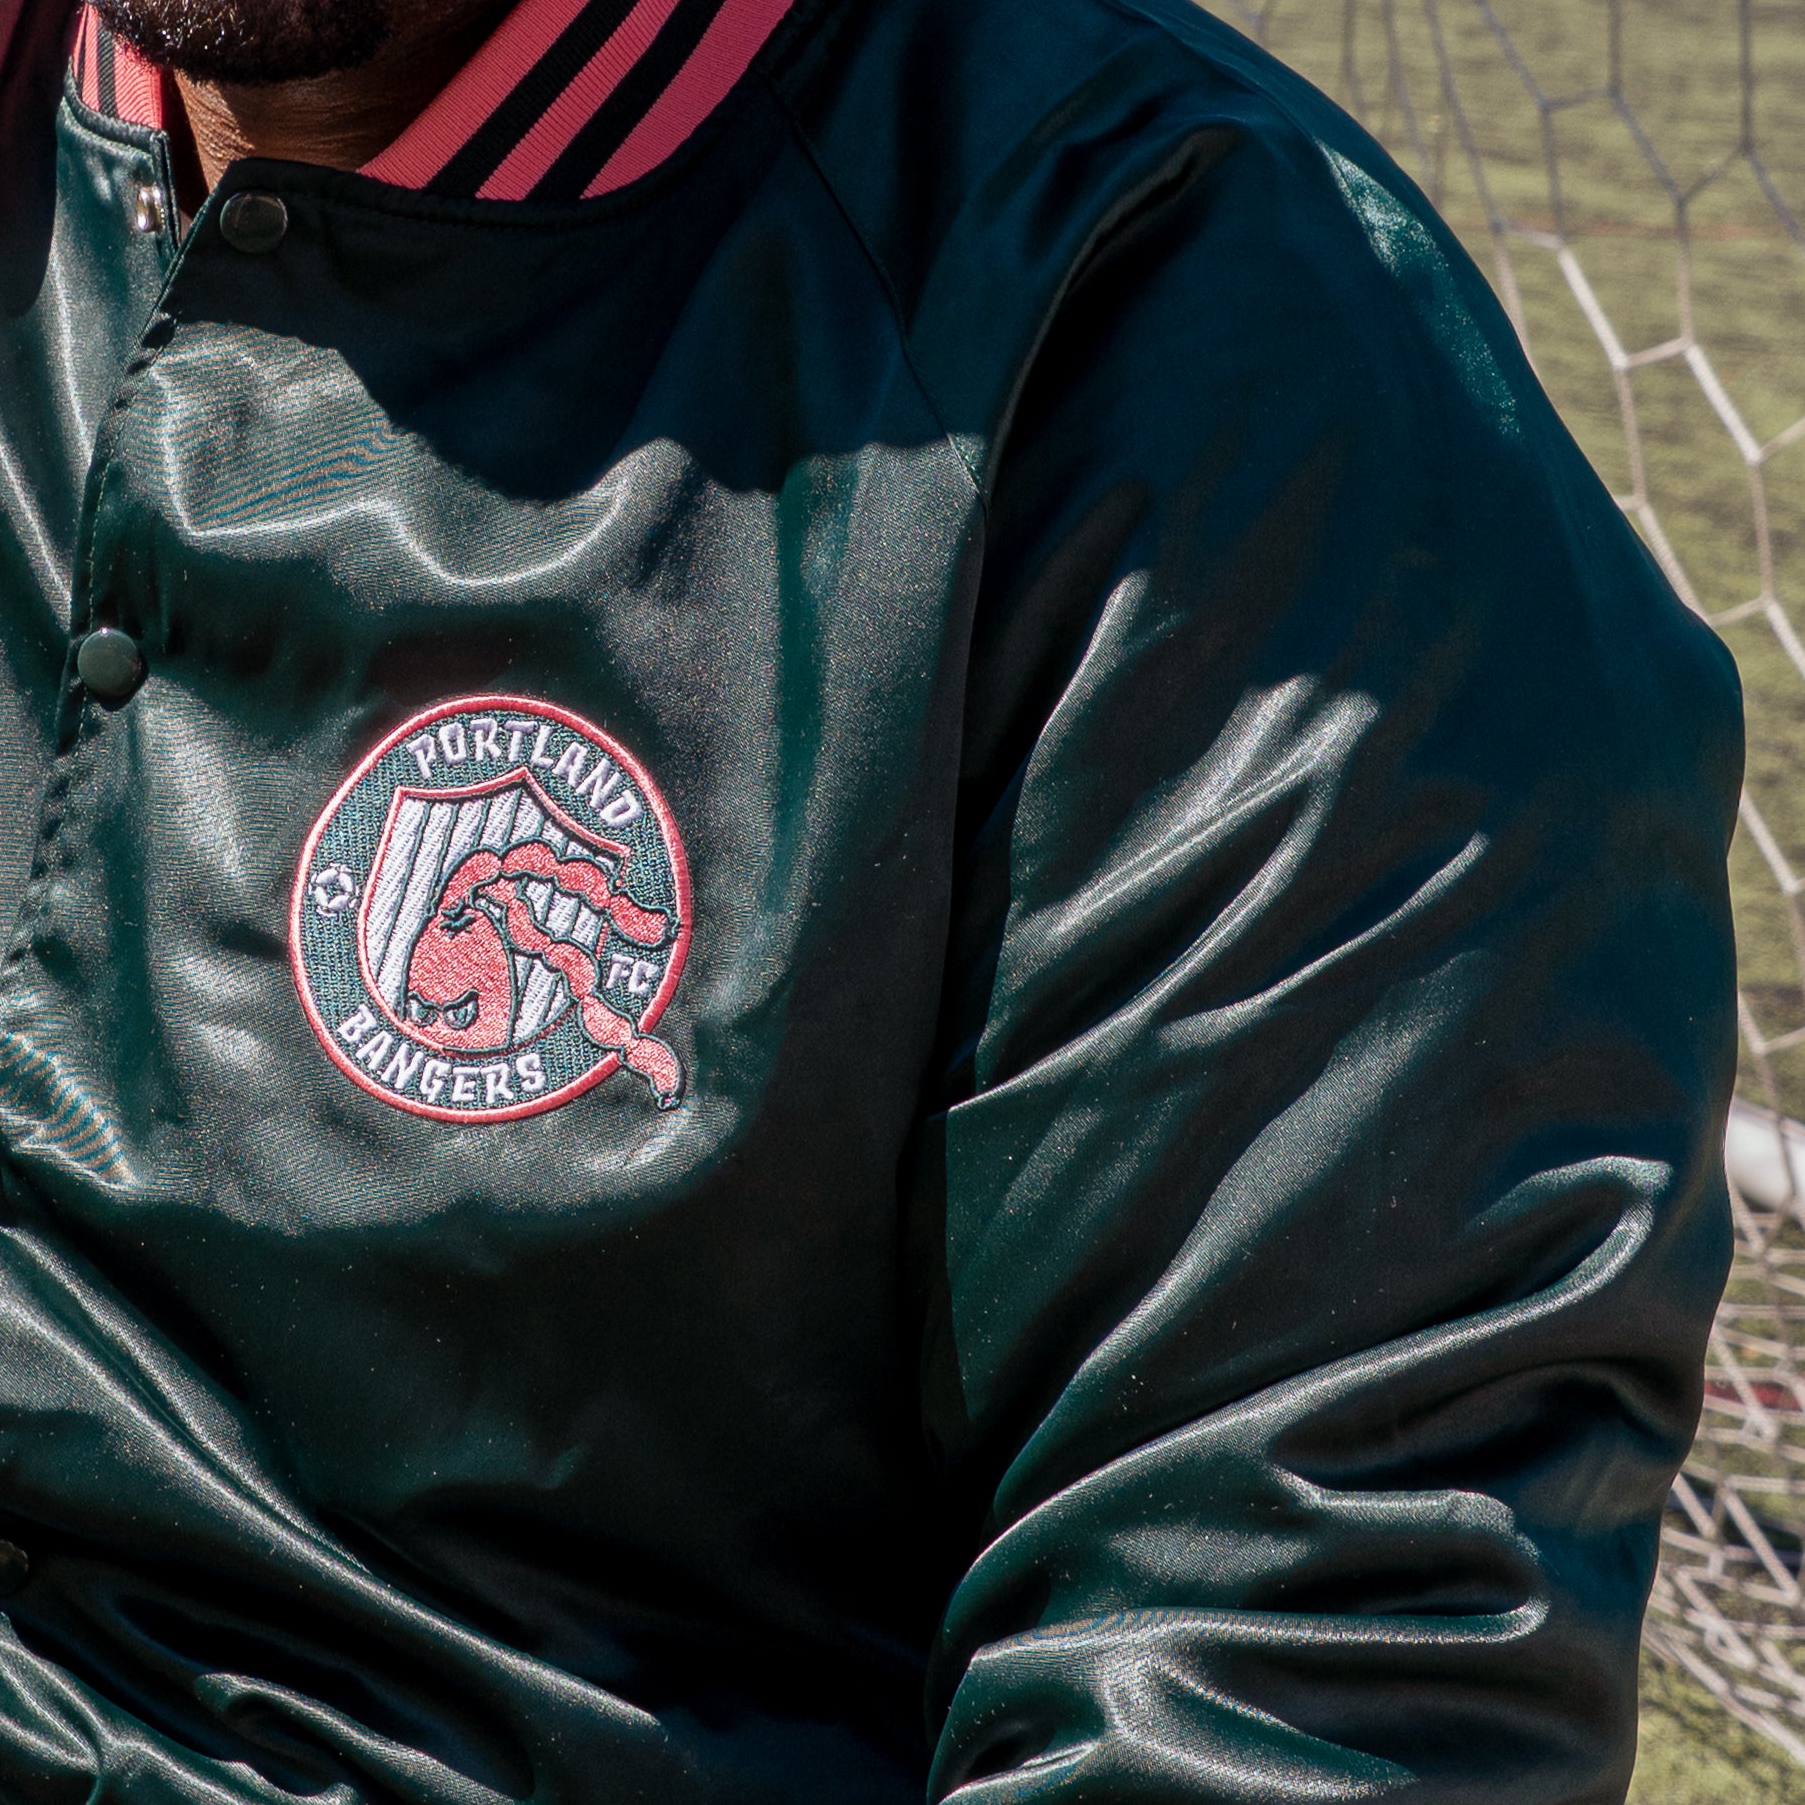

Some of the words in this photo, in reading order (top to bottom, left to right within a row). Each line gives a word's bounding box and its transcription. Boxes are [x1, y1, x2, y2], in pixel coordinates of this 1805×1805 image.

[406, 718, 643, 828] PORTLAND
[606, 954, 659, 993] FC
[337, 1005, 546, 1104] BANGERS
